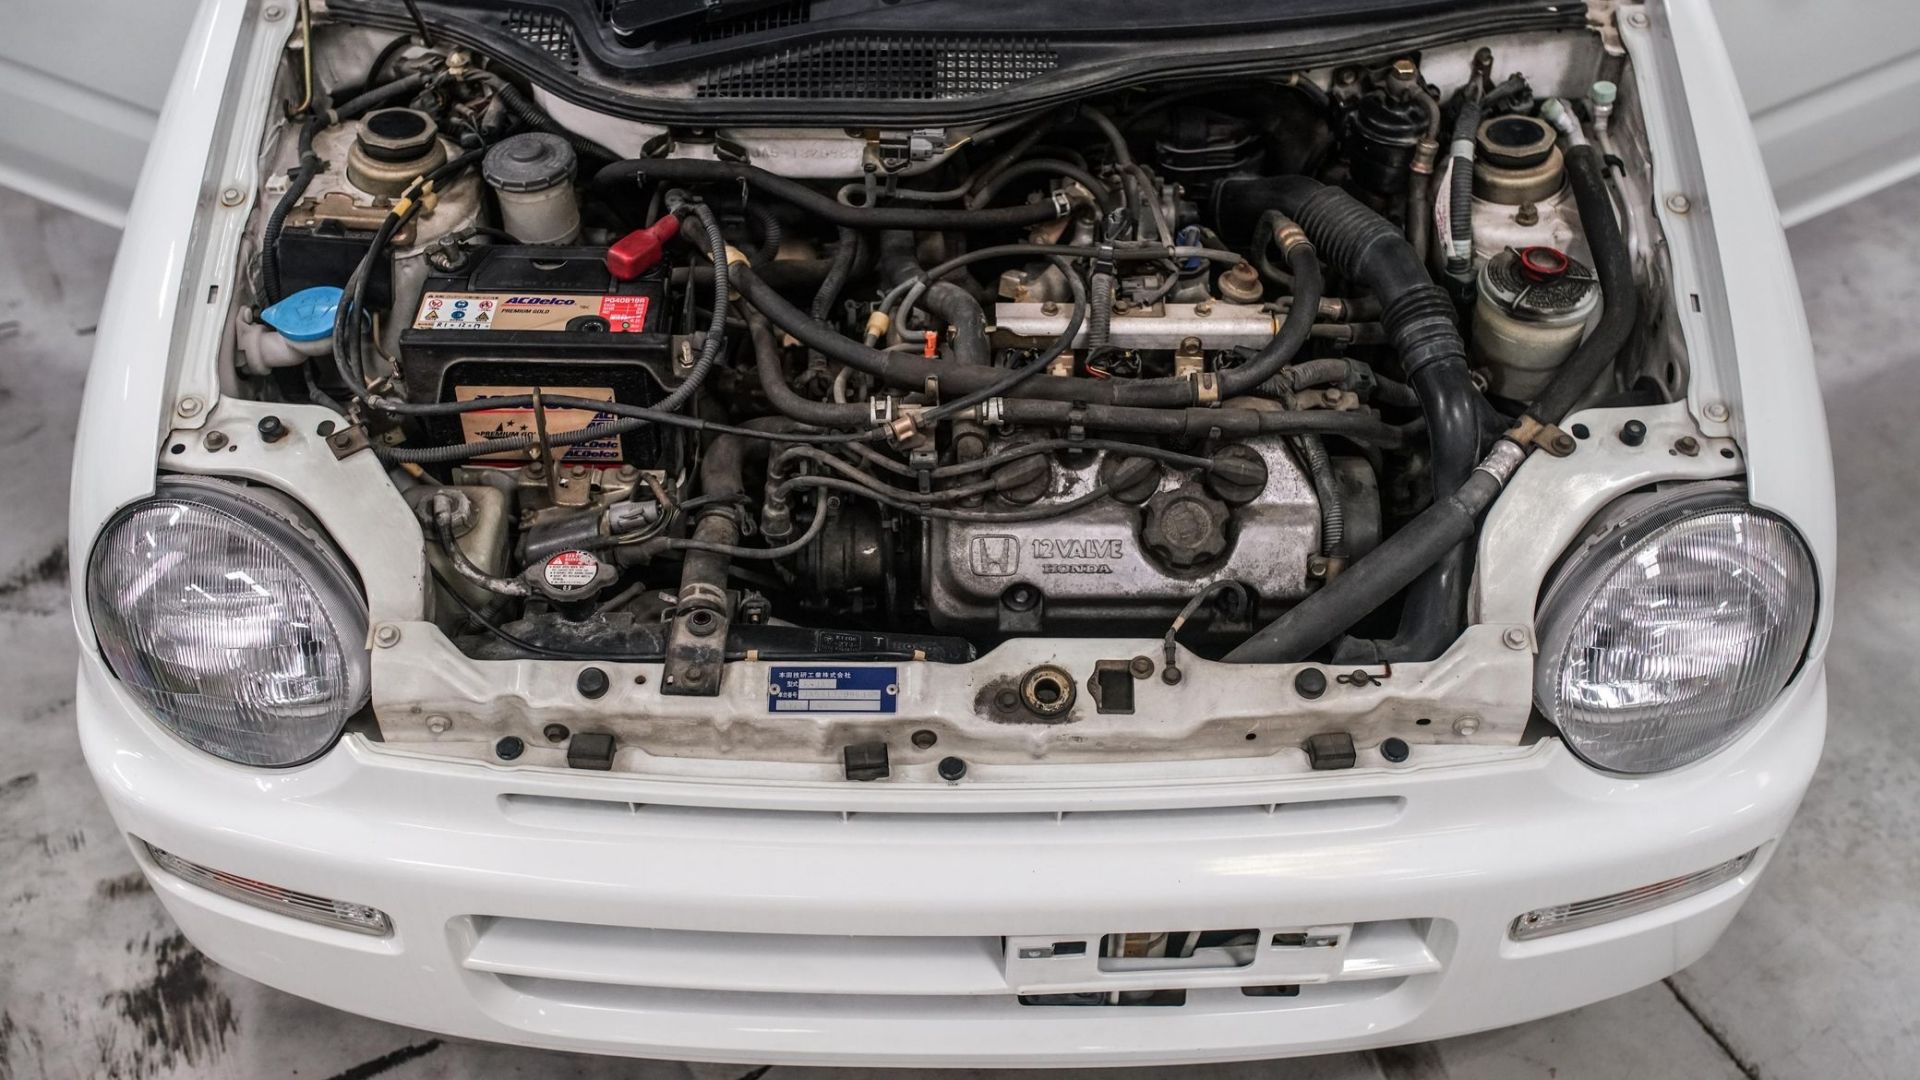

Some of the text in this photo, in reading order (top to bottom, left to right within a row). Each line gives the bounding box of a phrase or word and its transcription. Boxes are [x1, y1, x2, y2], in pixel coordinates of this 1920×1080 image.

[505, 297, 575, 305] ACDelco
[1031, 539, 1052, 559] 12
[1055, 539, 1123, 559] VALVE
[1042, 564, 1112, 574] HONDA
